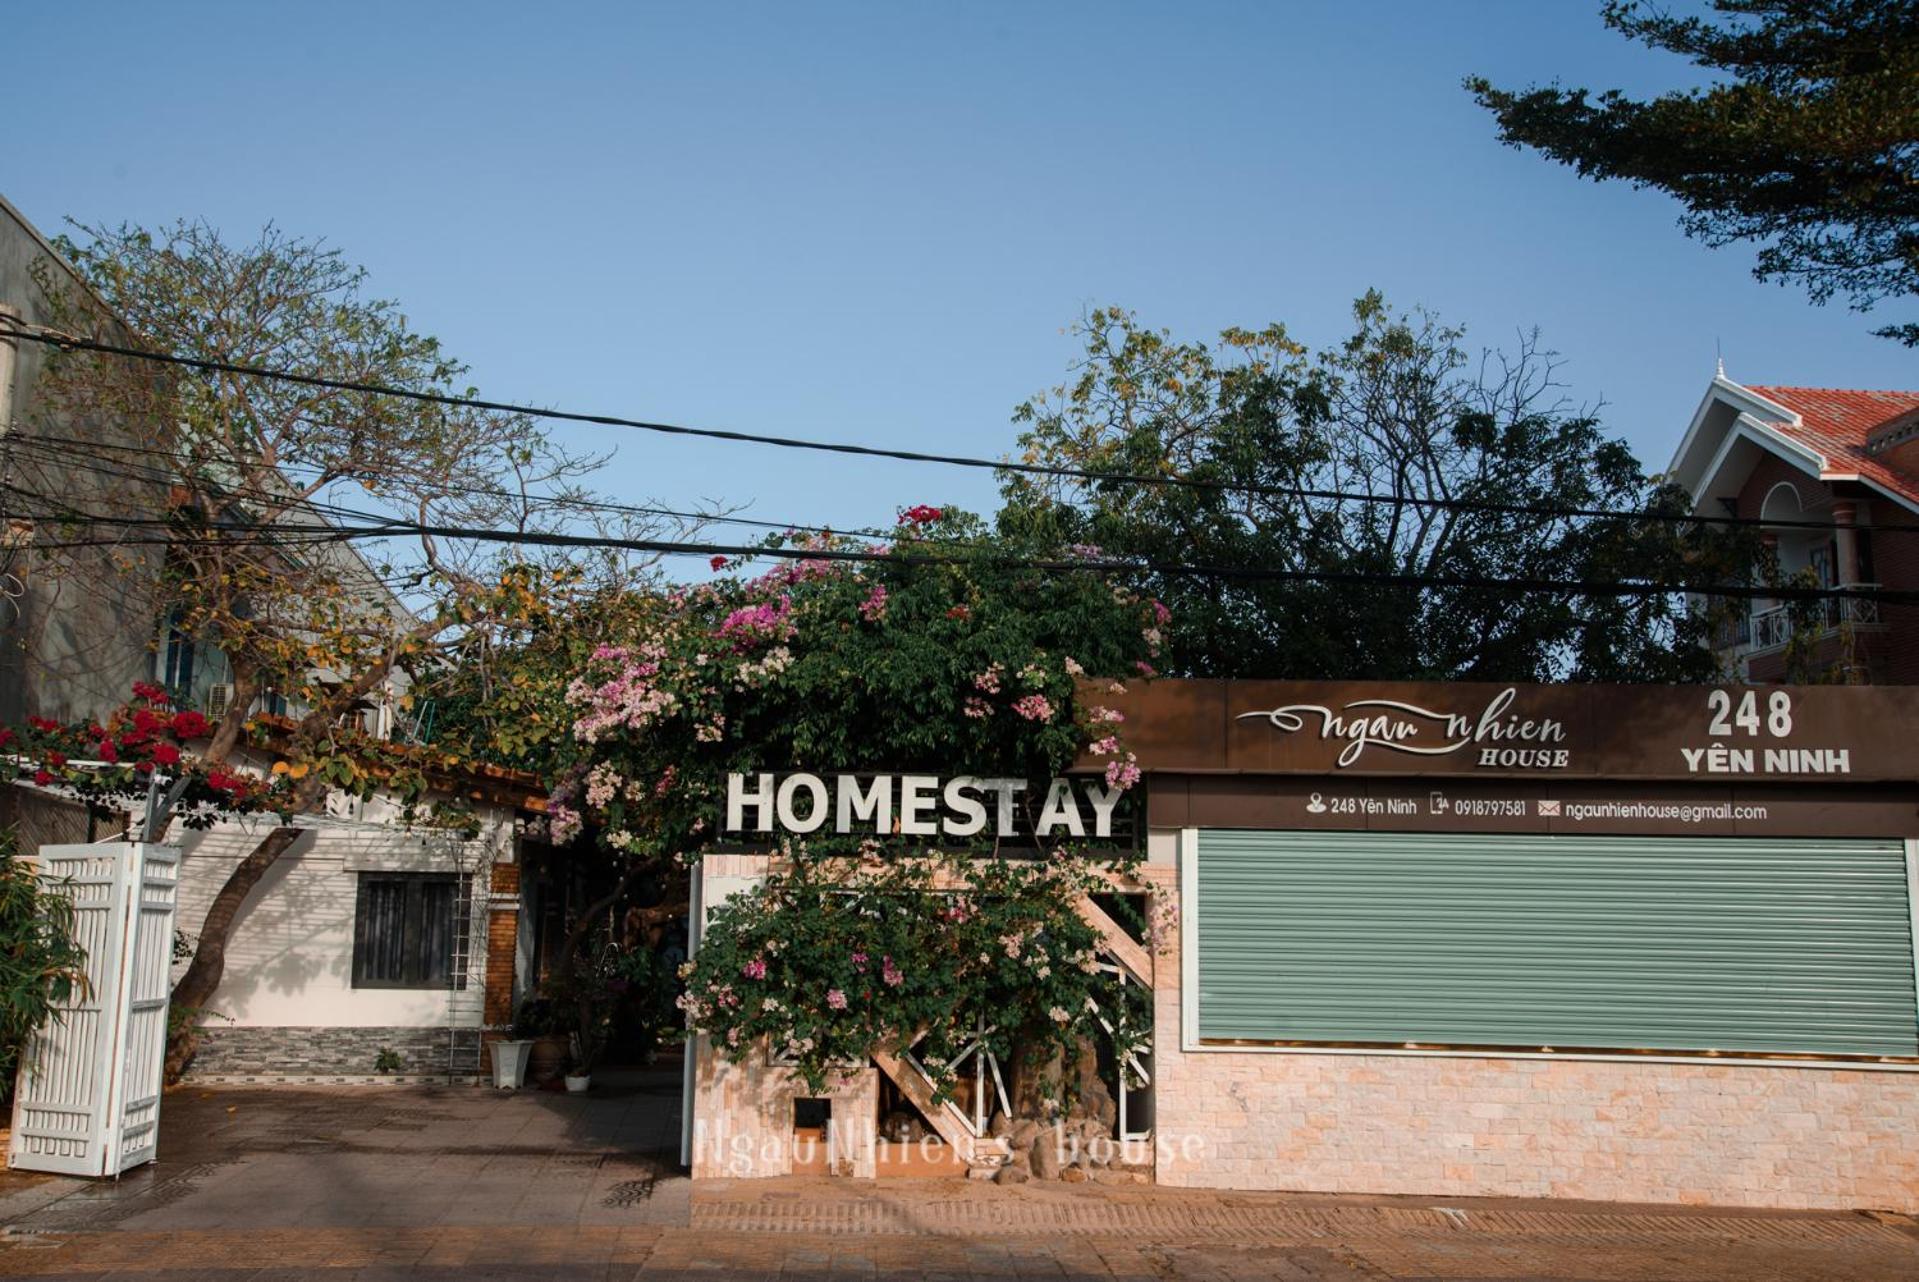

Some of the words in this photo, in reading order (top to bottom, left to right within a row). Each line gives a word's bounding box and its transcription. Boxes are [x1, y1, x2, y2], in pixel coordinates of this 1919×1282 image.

[1708, 689, 1792, 738] 248
[1477, 748, 1570, 768] HOUSE
[1680, 742, 1755, 773] YÊN
[1764, 748, 1851, 773] NINH
[726, 773, 1124, 838] HOMESTAY
[1330, 798, 1356, 814] 248
[1358, 797, 1384, 815] Yên
[1387, 798, 1417, 815] Ninh
[1455, 799, 1526, 816] 0918797581
[1565, 801, 1768, 823] ngaunhienhouse@gmail.com
